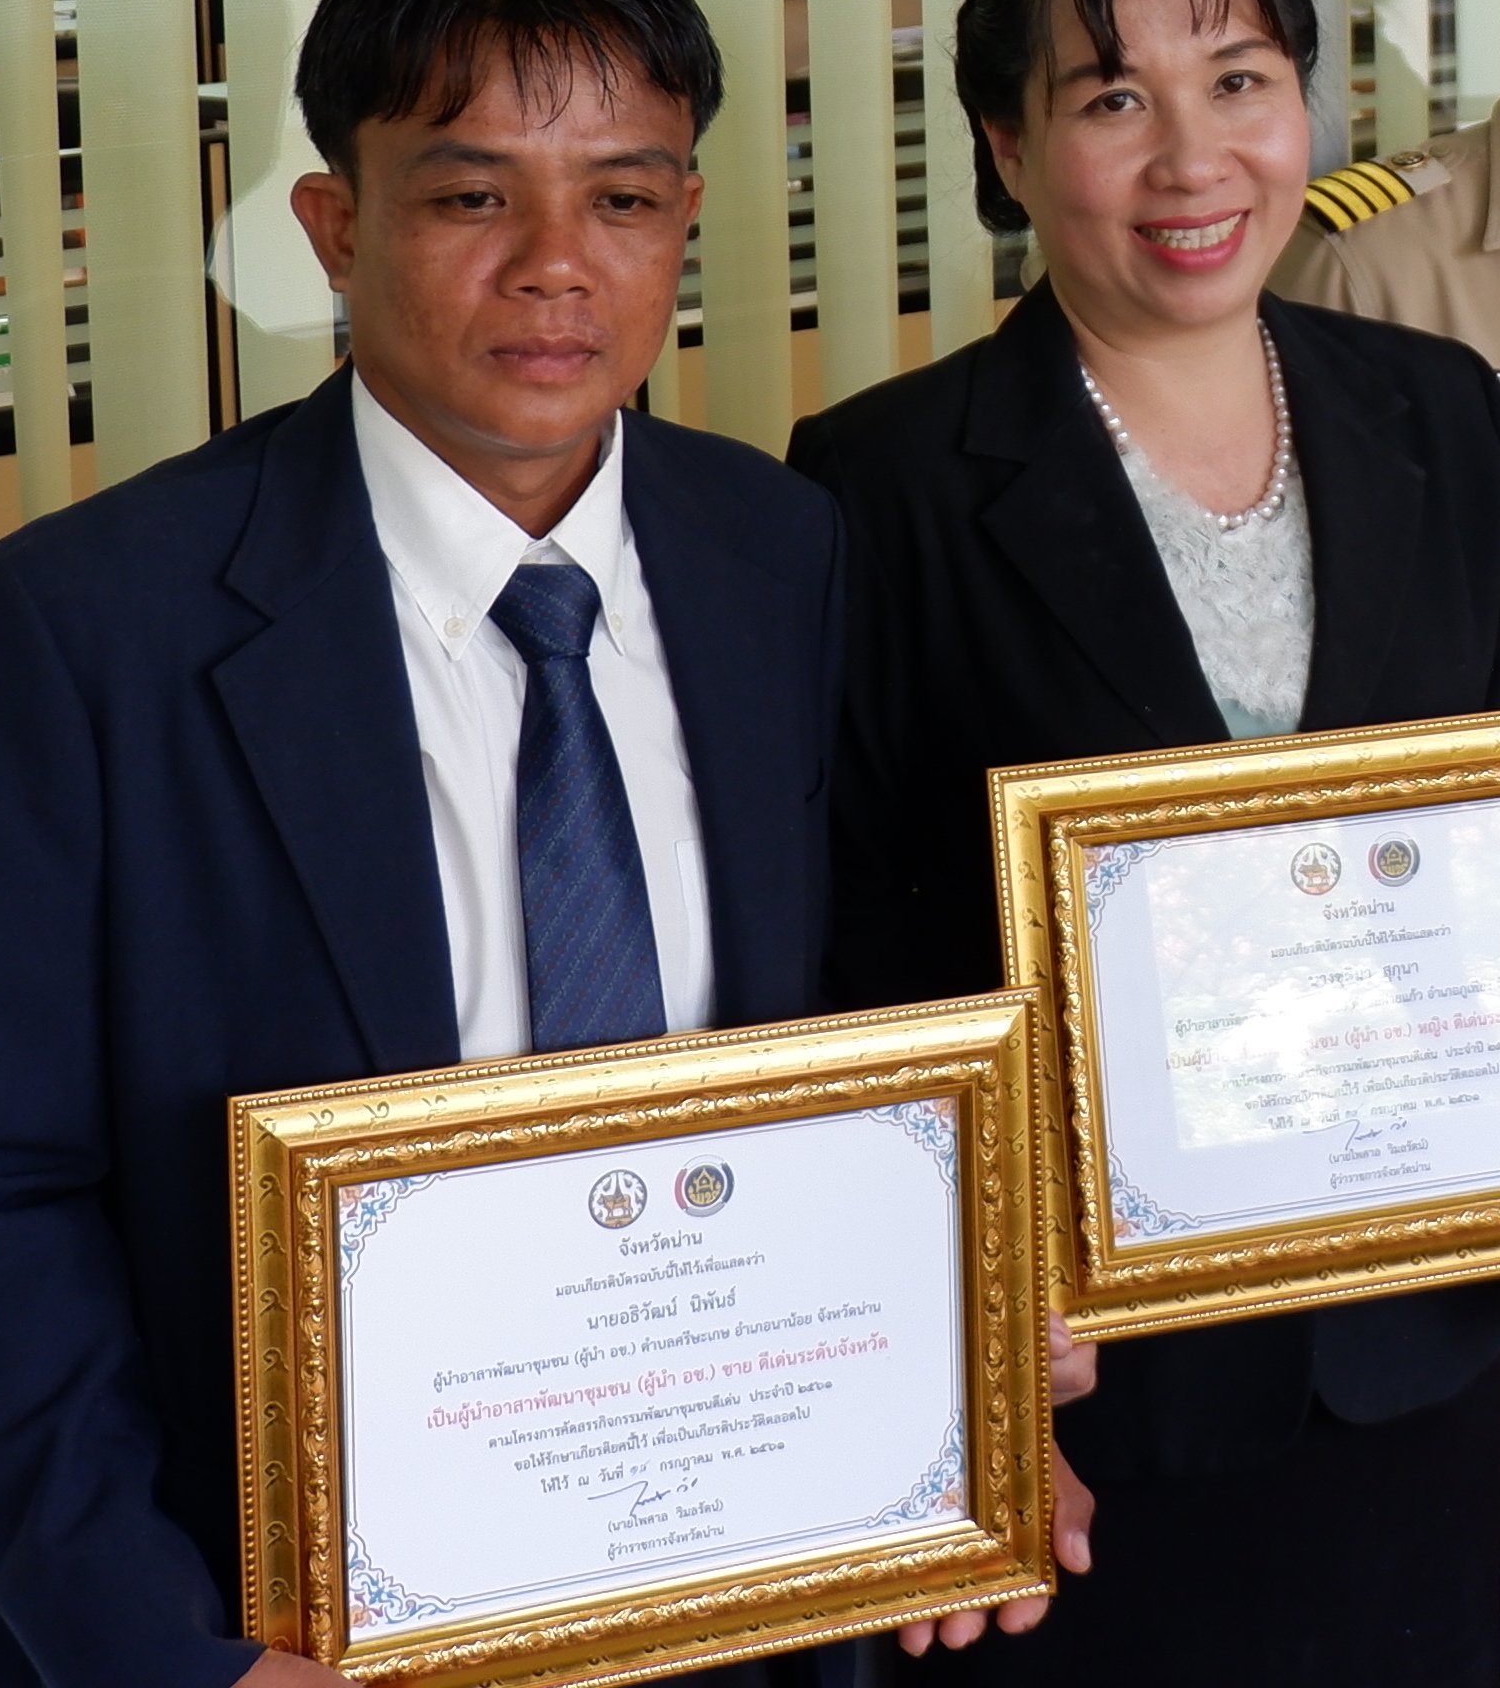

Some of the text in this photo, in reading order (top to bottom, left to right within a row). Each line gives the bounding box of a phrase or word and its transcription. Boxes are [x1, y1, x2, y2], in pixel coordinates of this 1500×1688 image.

[1322, 899, 1395, 921] จังหวัดน่าน
[1417, 1015, 1448, 1038] หญิง
[1329, 1161, 1432, 1190] ผู้ว่าราชการจังหวัดน่าน
[618, 1228, 703, 1257] จังหวัดน่าน
[555, 1251, 766, 1297] มอบเกียรติบัตรฉบับนี้ให้ไว้เพื่อแสดงว่า
[586, 1285, 737, 1330] นายอธิวัฒน์ นิพันธ์
[432, 1352, 569, 1393] ผู้นำอาสาพัฒนาชุมชน
[574, 1346, 605, 1369] (ผู้นำ
[817, 1300, 882, 1323] จังหวัดน่าน
[426, 1331, 889, 1430] เป็นผู้นำอาสาพัฒนาชุมชน (ผู้นำ อช.) ชาย ดีเด่นระดับจังหวัด
[749, 1380, 794, 1403] ประจำปี
[540, 1472, 569, 1494] ให้ไว้
[599, 1460, 624, 1483] วันที่
[659, 1451, 714, 1473] กรกฎาคม
[721, 1445, 745, 1461] พ.ศ.
[607, 1509, 668, 1533] (นายไพศาล
[675, 1497, 724, 1521] วิมลรัตน์)
[607, 1524, 725, 1562] ผู้ว่าราชการจังหวัดน่าน
